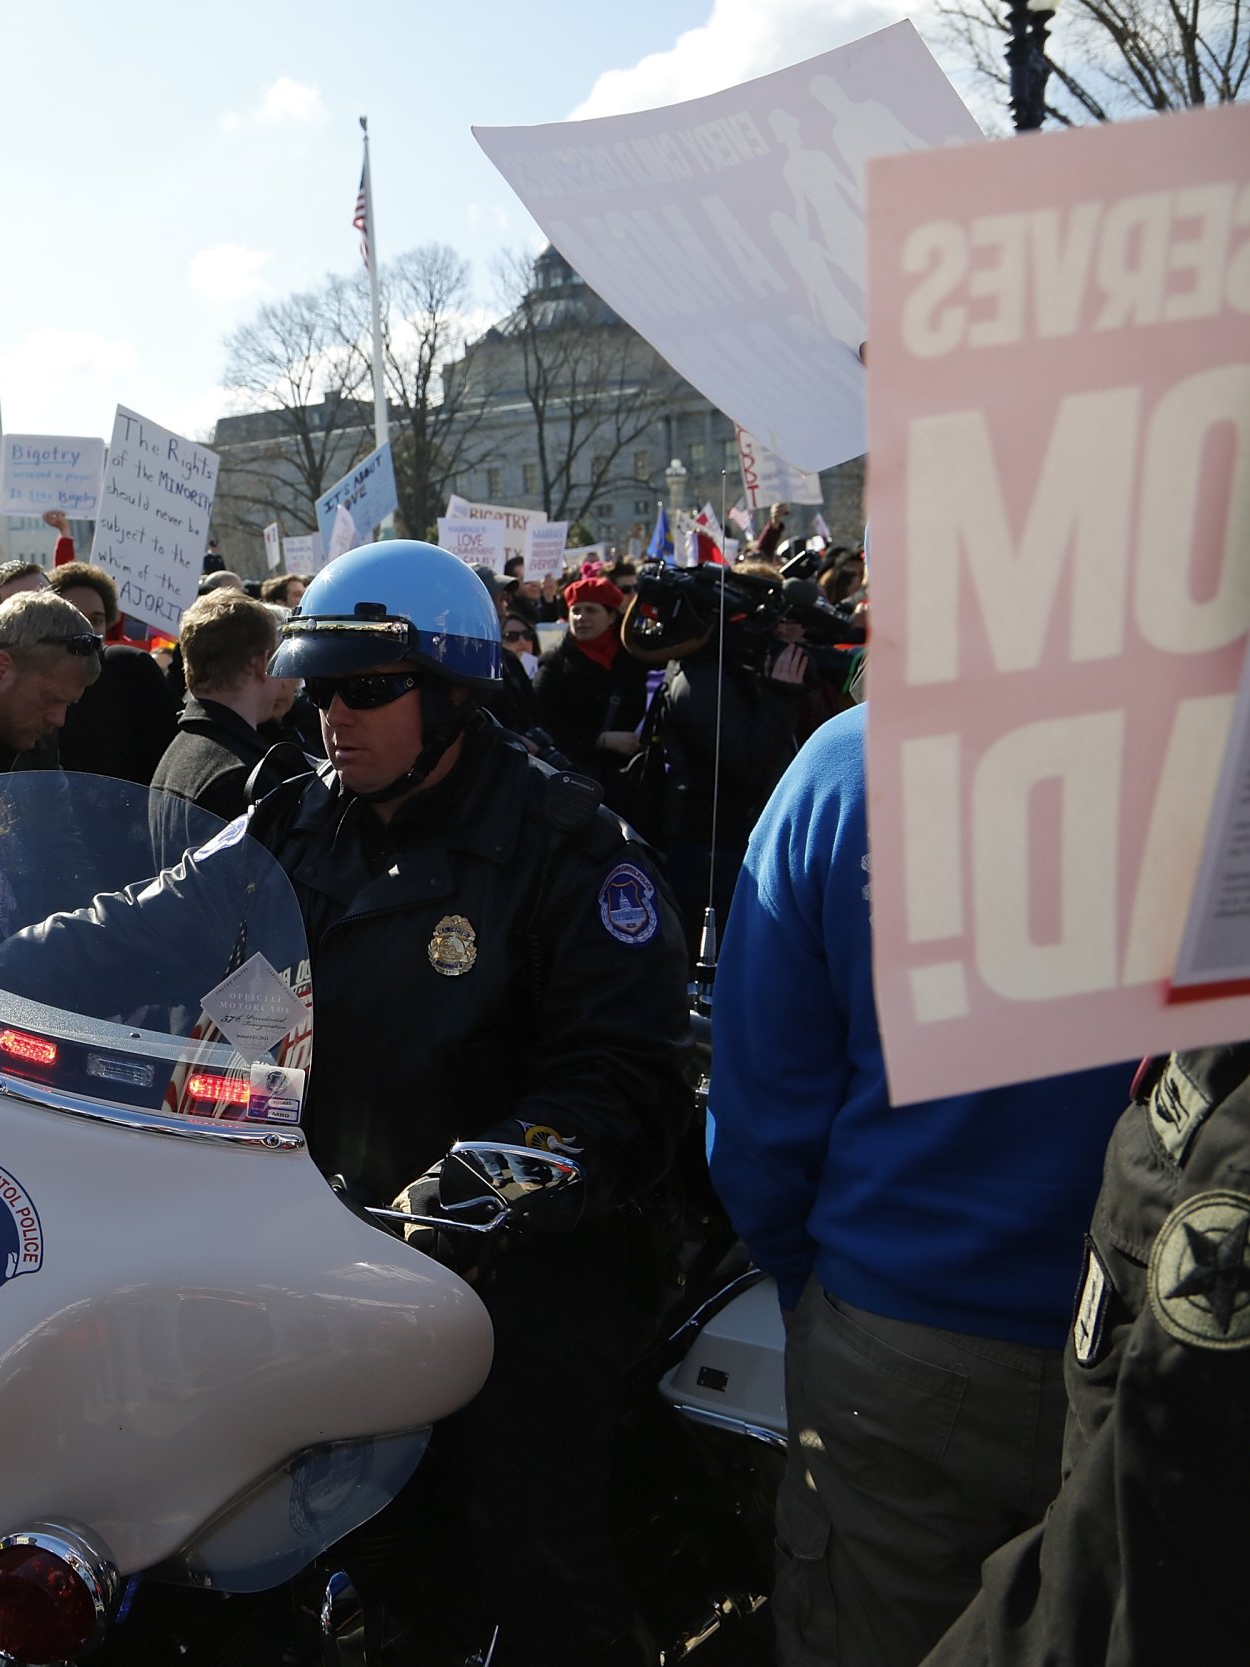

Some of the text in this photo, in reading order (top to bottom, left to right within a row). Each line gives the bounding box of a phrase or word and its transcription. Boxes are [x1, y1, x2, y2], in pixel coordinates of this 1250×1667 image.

[12, 444, 80, 468] Bigotry
[118, 413, 214, 481] The Rights
[106, 477, 200, 536] should never be
[112, 451, 214, 517] of the MINORITY
[338, 484, 368, 512] OVE
[101, 513, 192, 570] subject to the
[457, 533, 484, 547] LOVE
[98, 545, 182, 597] whim of the
[117, 580, 182, 624] AJORIT
[16, 1206, 39, 1264] POLICE
